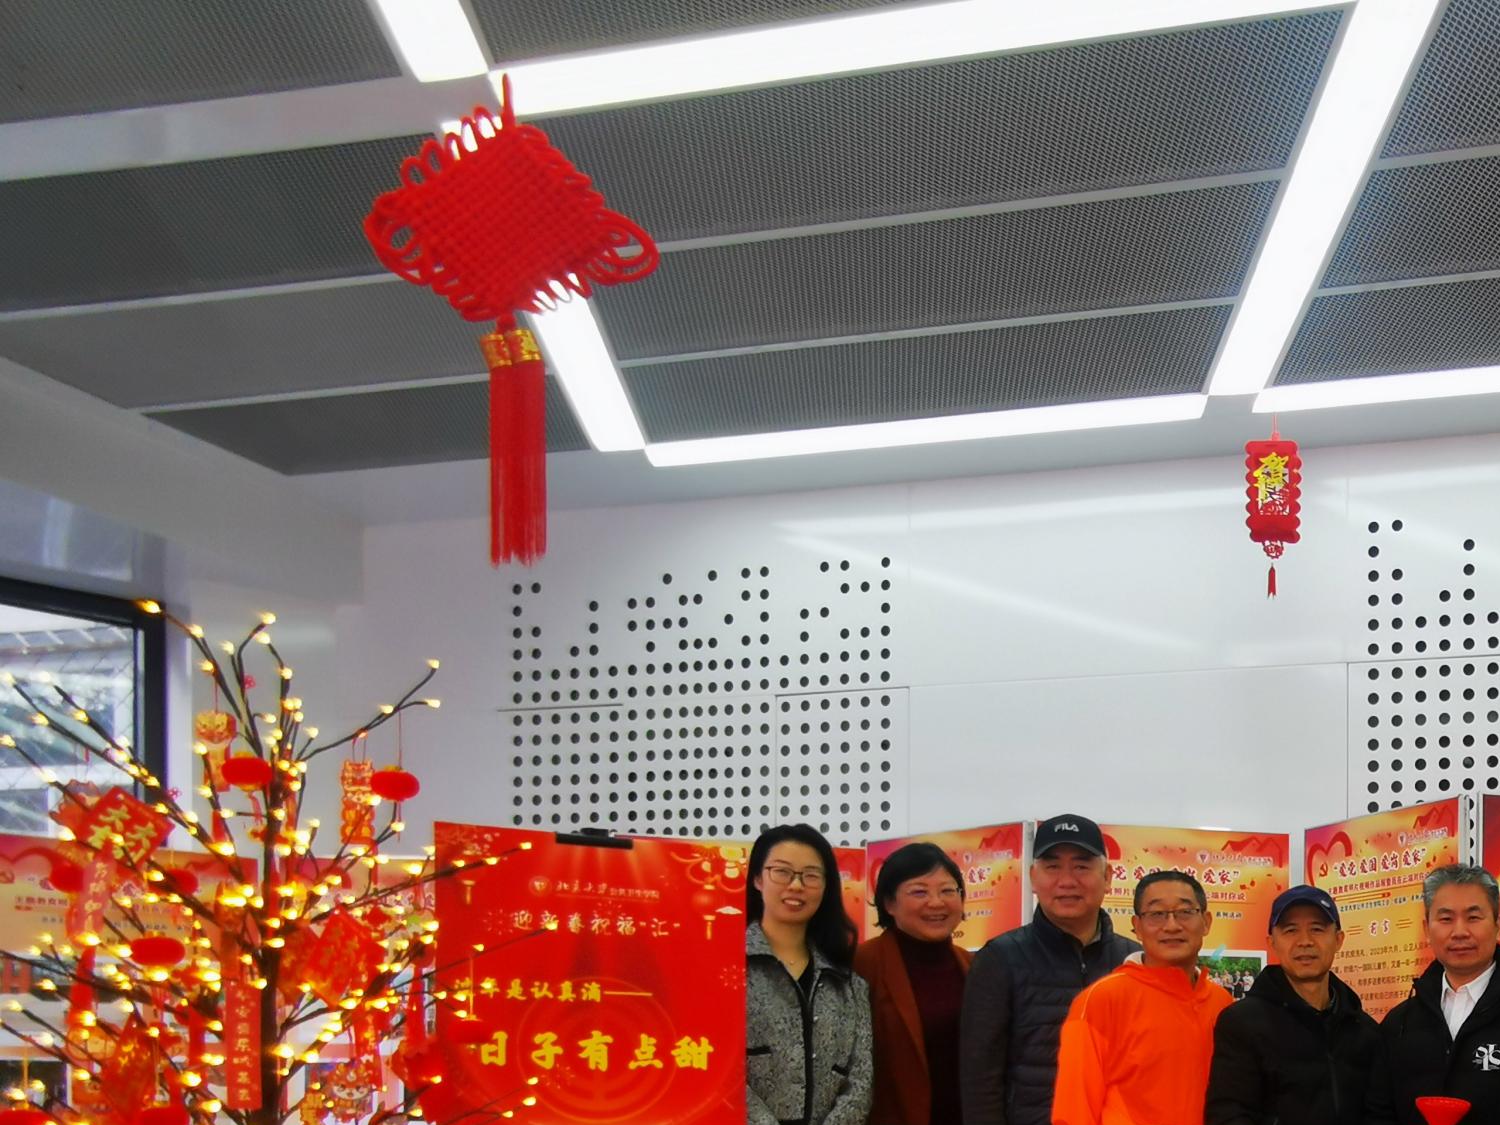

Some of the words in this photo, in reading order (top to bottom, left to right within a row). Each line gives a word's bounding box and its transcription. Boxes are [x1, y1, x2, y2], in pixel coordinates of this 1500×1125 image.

[1054, 823, 1080, 833] FILA
[480, 1030, 714, 1072] 日子有点甜
